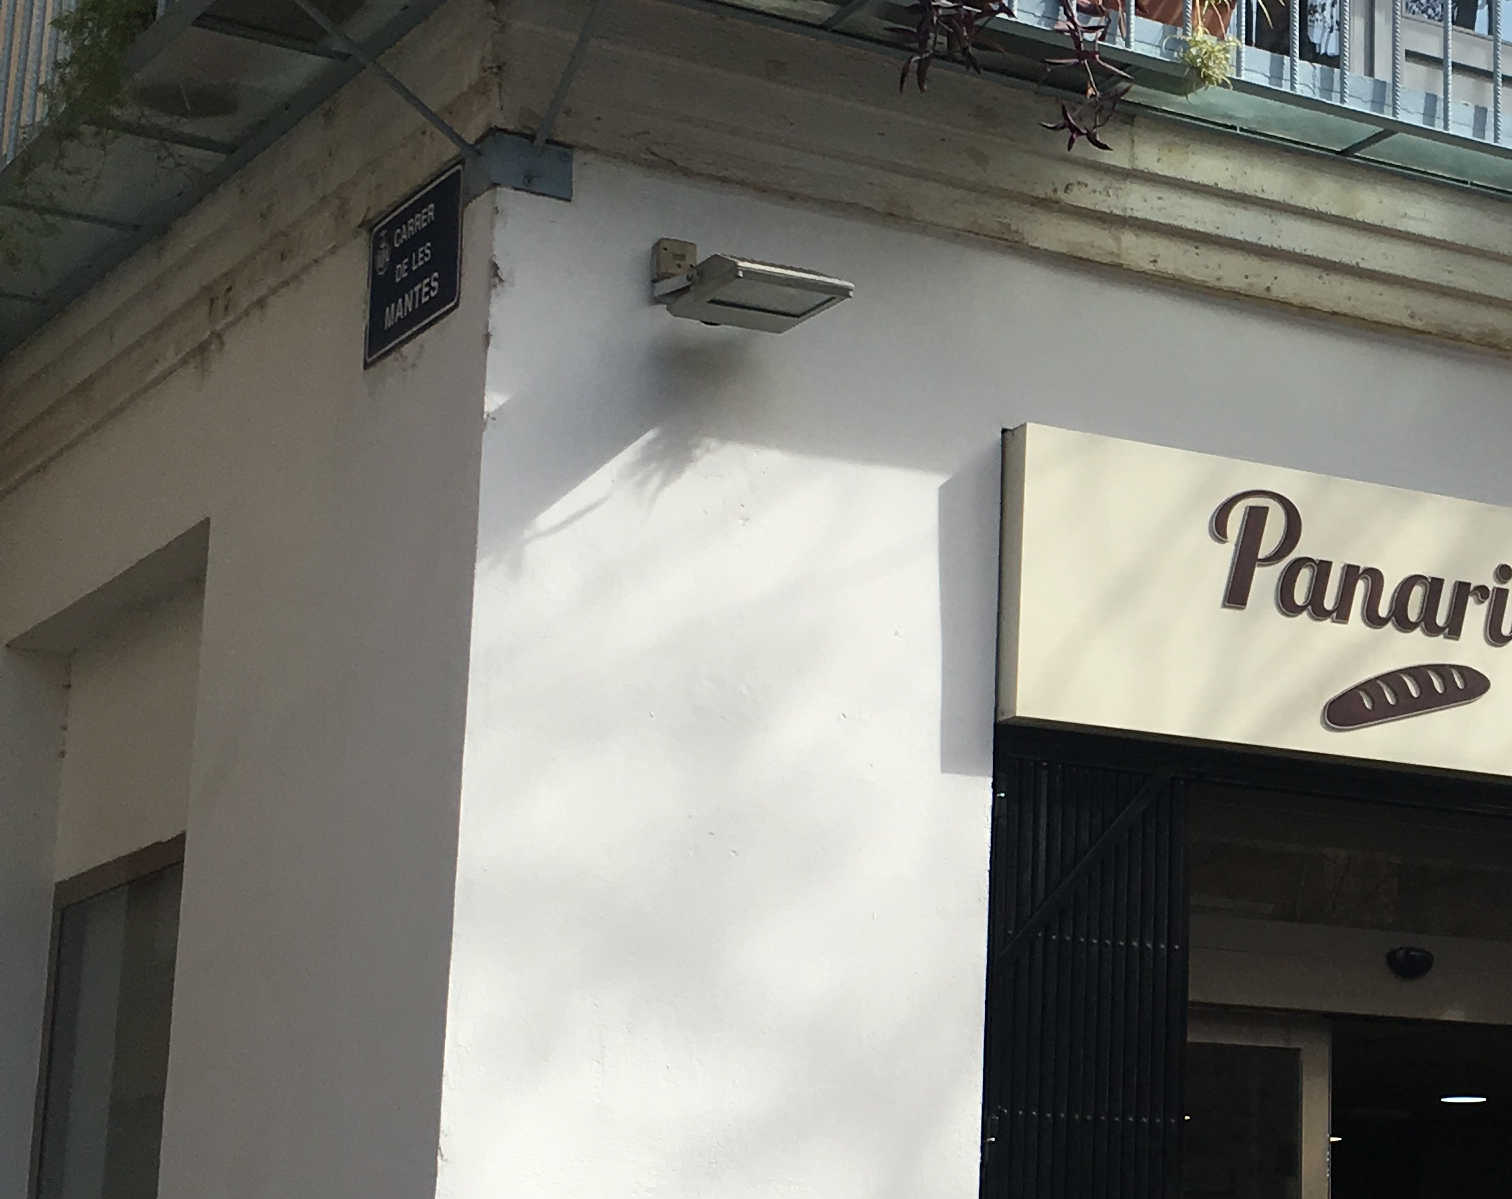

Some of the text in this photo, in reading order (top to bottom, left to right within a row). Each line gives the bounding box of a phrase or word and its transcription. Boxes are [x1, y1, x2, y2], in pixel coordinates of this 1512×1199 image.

[393, 203, 436, 248] CARRER
[395, 242, 432, 283] DE LES
[383, 271, 440, 331] MANTES
